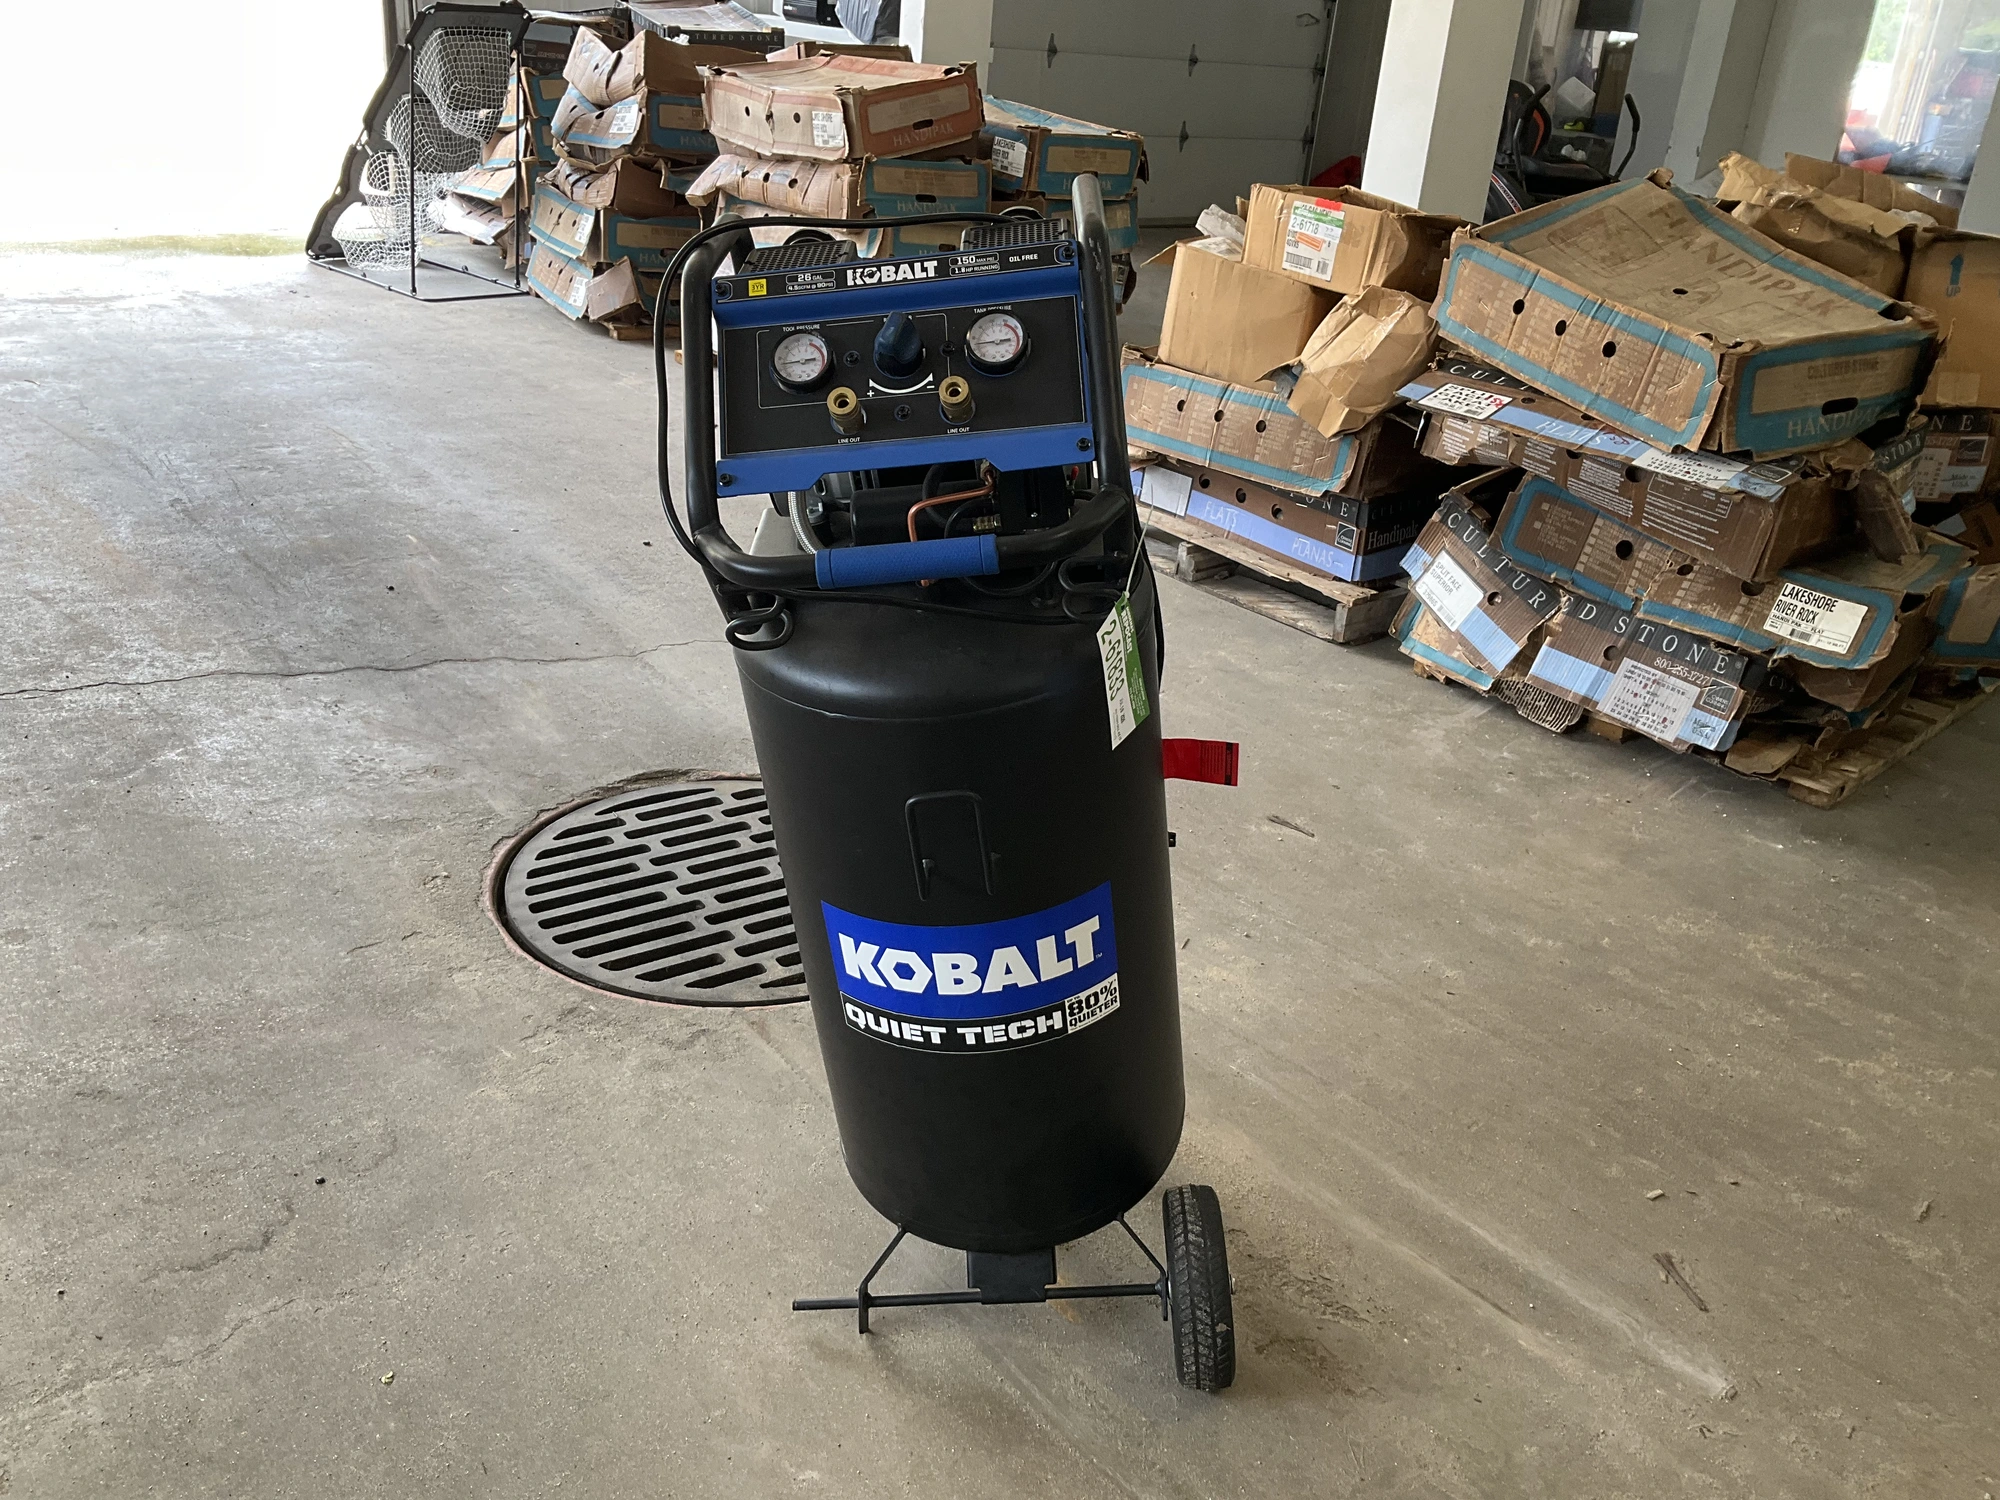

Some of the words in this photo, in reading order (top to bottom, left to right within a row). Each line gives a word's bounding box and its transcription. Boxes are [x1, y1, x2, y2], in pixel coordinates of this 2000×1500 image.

[680, 136, 716, 148] HAND
[893, 121, 954, 147] HANDIPAK
[1291, 217, 1320, 235] 2-61718
[957, 255, 976, 265] 150
[1009, 255, 1021, 263] OIL
[1022, 253, 1039, 262] FREE
[797, 273, 811, 282] 26
[846, 260, 938, 286] KOBALT
[1946, 285, 1961, 298] UP
[1881, 433, 1921, 464] STONE
[1203, 501, 1239, 528] FLATS
[1367, 520, 1419, 550] Handipak
[1292, 537, 1334, 568] PLANAS
[1429, 568, 1455, 596] SUPERIOR
[1435, 561, 1450, 579] SPLIT
[1447, 574, 1463, 592] FACE
[1774, 598, 1798, 617] RIVER
[1796, 606, 1819, 625] ROCK
[1782, 584, 1838, 613] LAKESHORE
[1772, 612, 1790, 624] HANDI
[1790, 619, 1802, 628] PAK
[1613, 615, 1730, 675] STONE
[1101, 619, 1124, 702] 2-61833
[838, 914, 1100, 996] KOBALT
[1067, 980, 1118, 1018] 80%
[1069, 995, 1118, 1028] QUIETER
[845, 1002, 947, 1045] QUIET
[956, 1010, 1064, 1046] TECH
